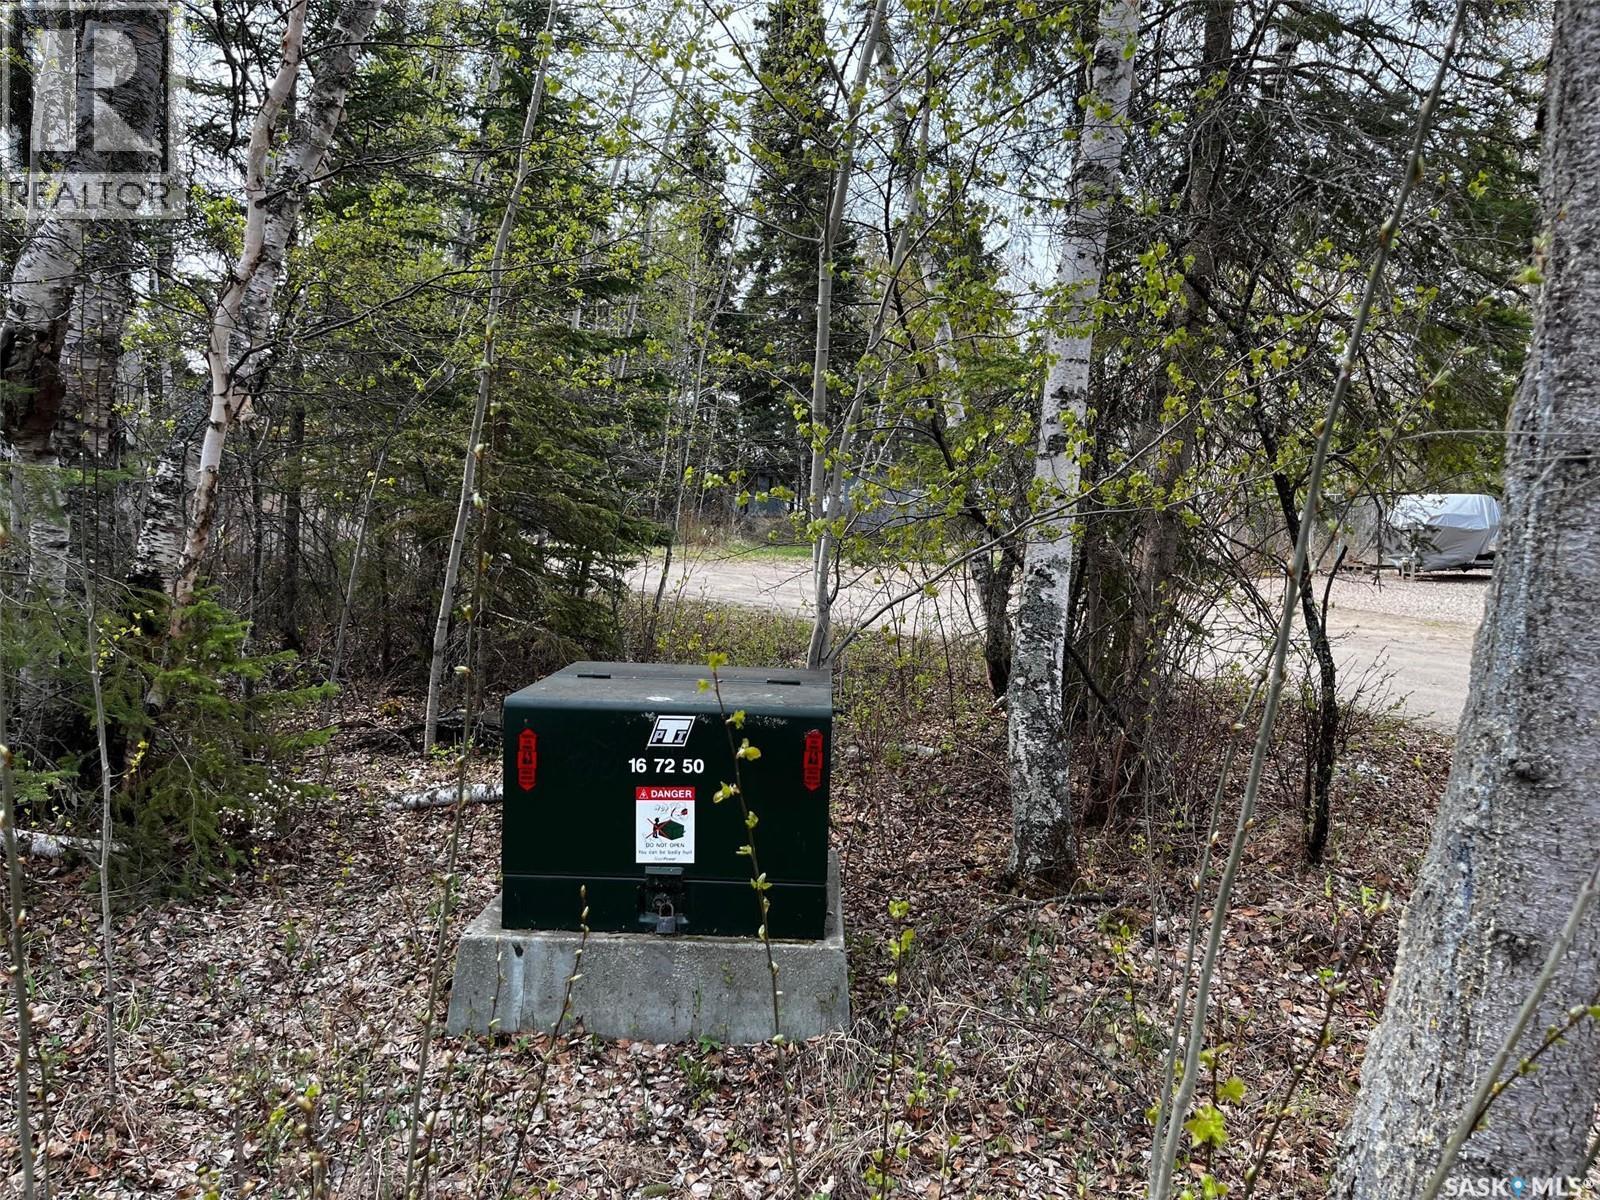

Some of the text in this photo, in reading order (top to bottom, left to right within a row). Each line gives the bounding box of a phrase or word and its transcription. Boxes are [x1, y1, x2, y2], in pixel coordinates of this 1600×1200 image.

[651, 719, 692, 744] PTI
[628, 757, 705, 774] 16 72 50
[650, 789, 693, 799] DANGER
